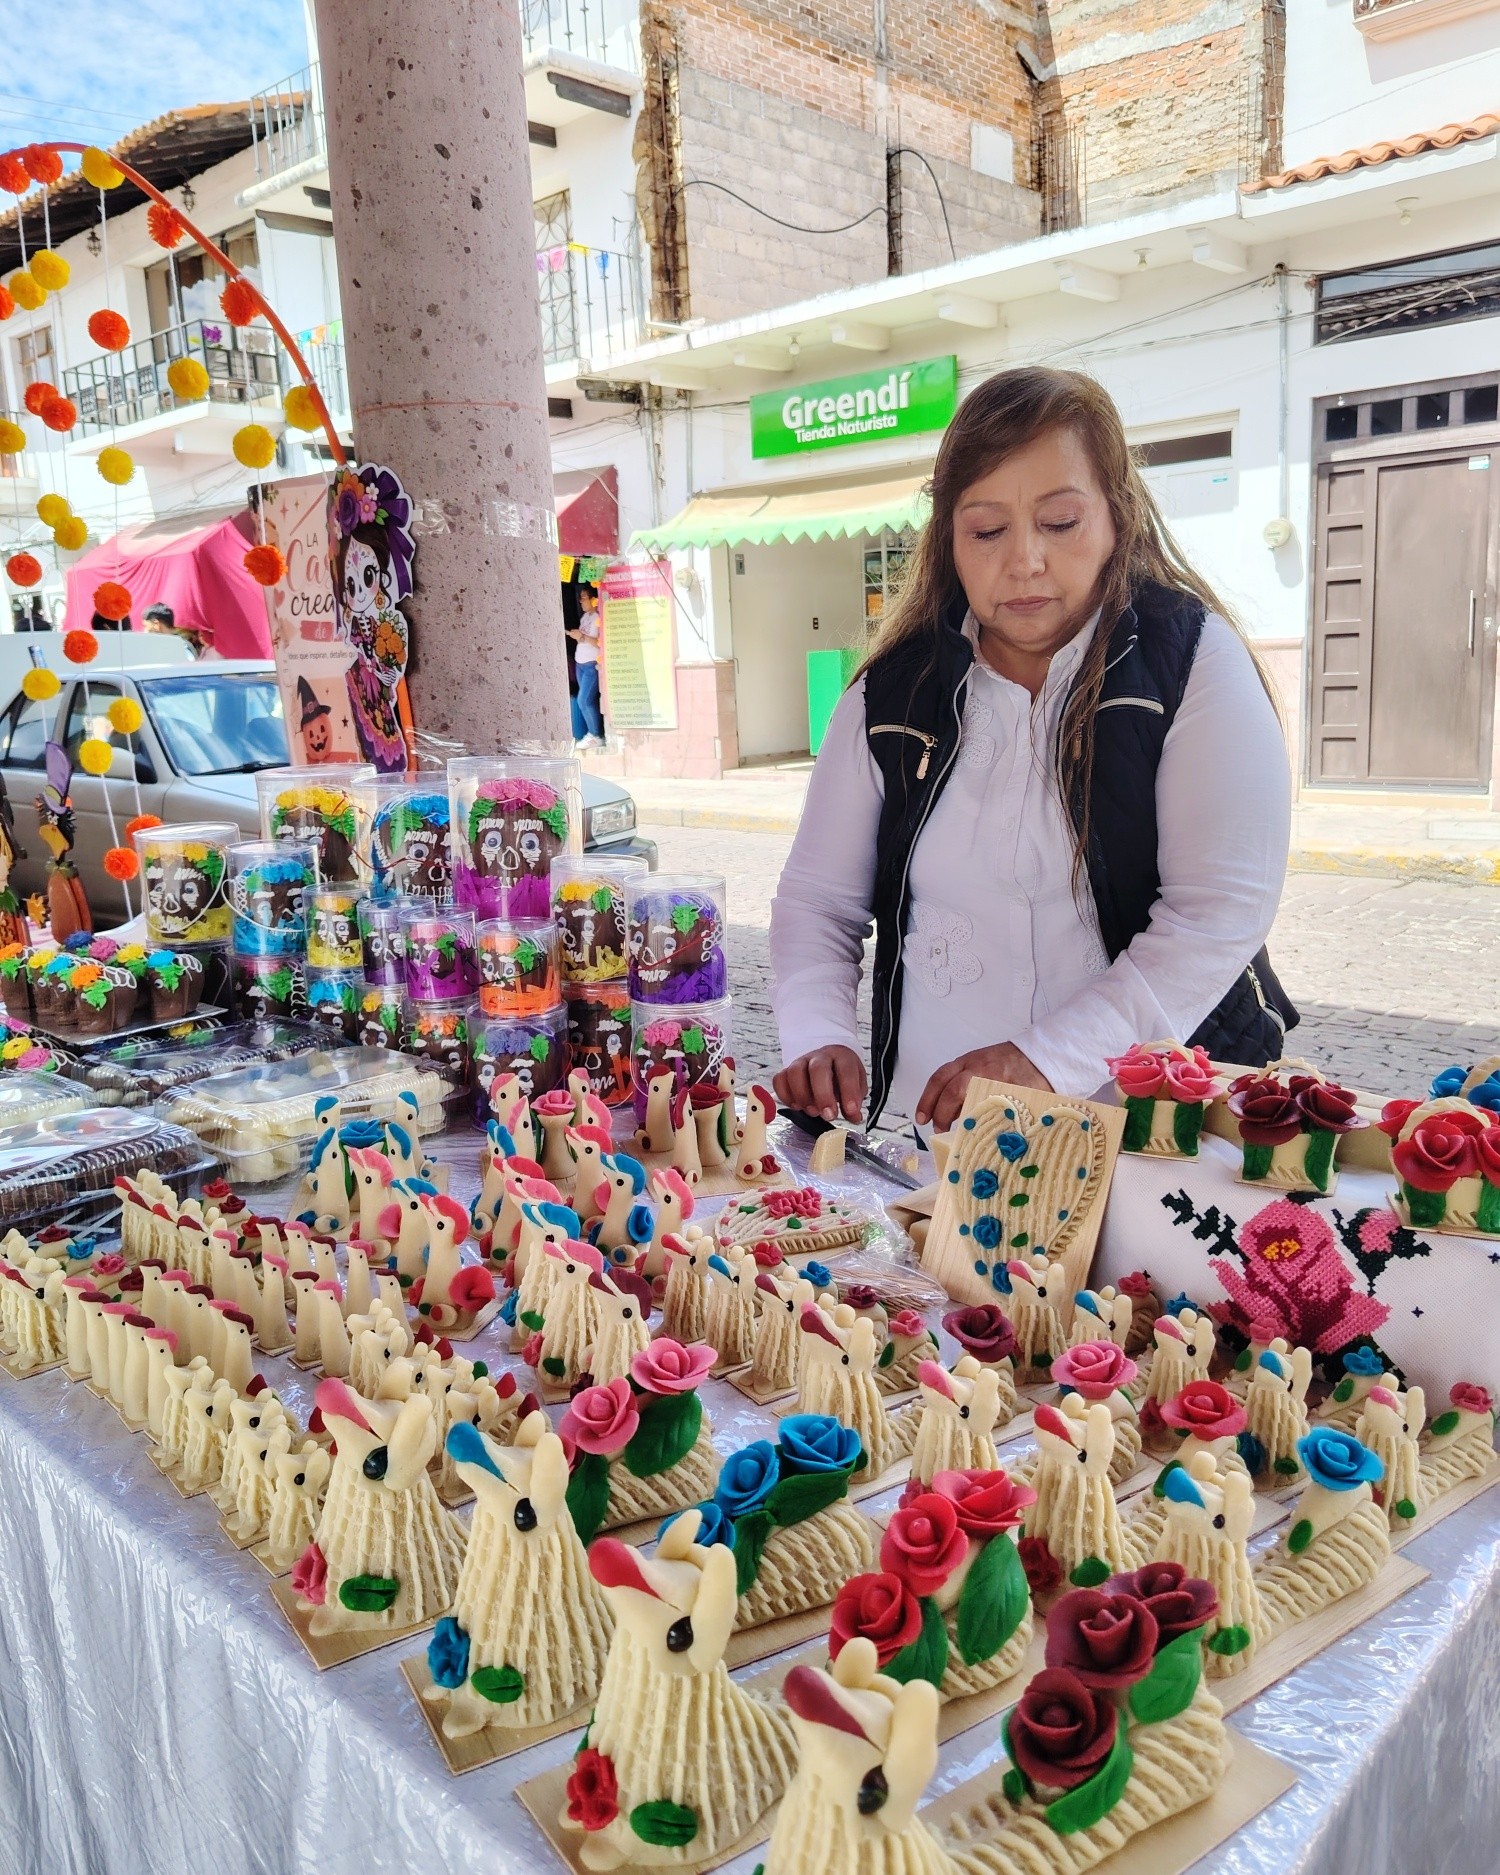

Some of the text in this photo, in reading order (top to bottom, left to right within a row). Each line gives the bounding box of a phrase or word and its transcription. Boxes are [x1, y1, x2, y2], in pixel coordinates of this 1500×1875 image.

[782, 371, 914, 430] Greendí
[794, 414, 898, 443] Tienda Naturista
[306, 532, 318, 548] LA
